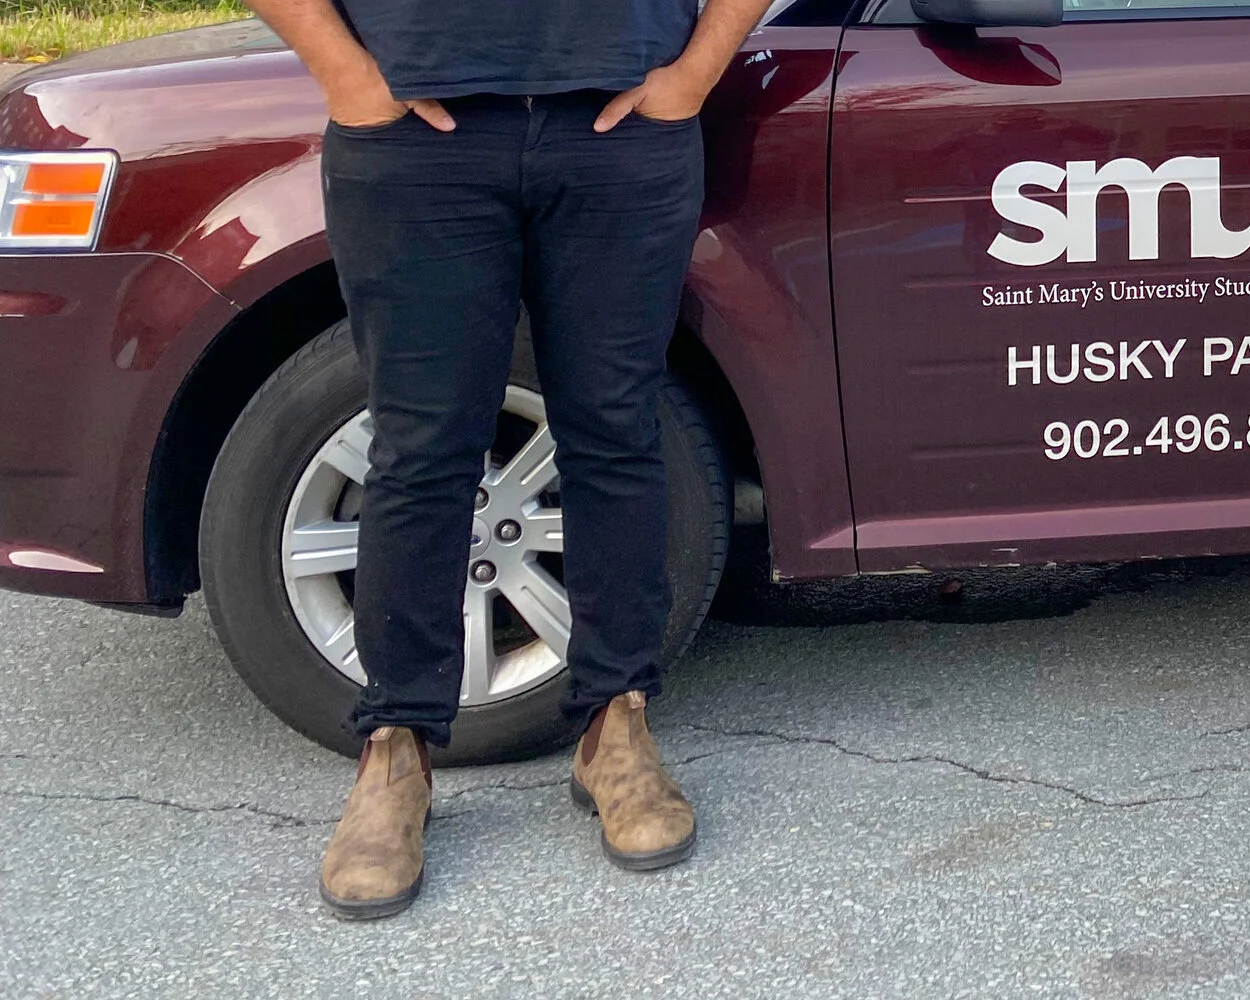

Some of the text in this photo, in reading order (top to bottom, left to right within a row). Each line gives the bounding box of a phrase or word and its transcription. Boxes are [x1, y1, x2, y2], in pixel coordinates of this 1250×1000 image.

[982, 286, 1034, 307] Saint
[1038, 280, 1104, 308] Mary's
[1110, 277, 1210, 303] University
[1007, 339, 1187, 386] HUSKY
